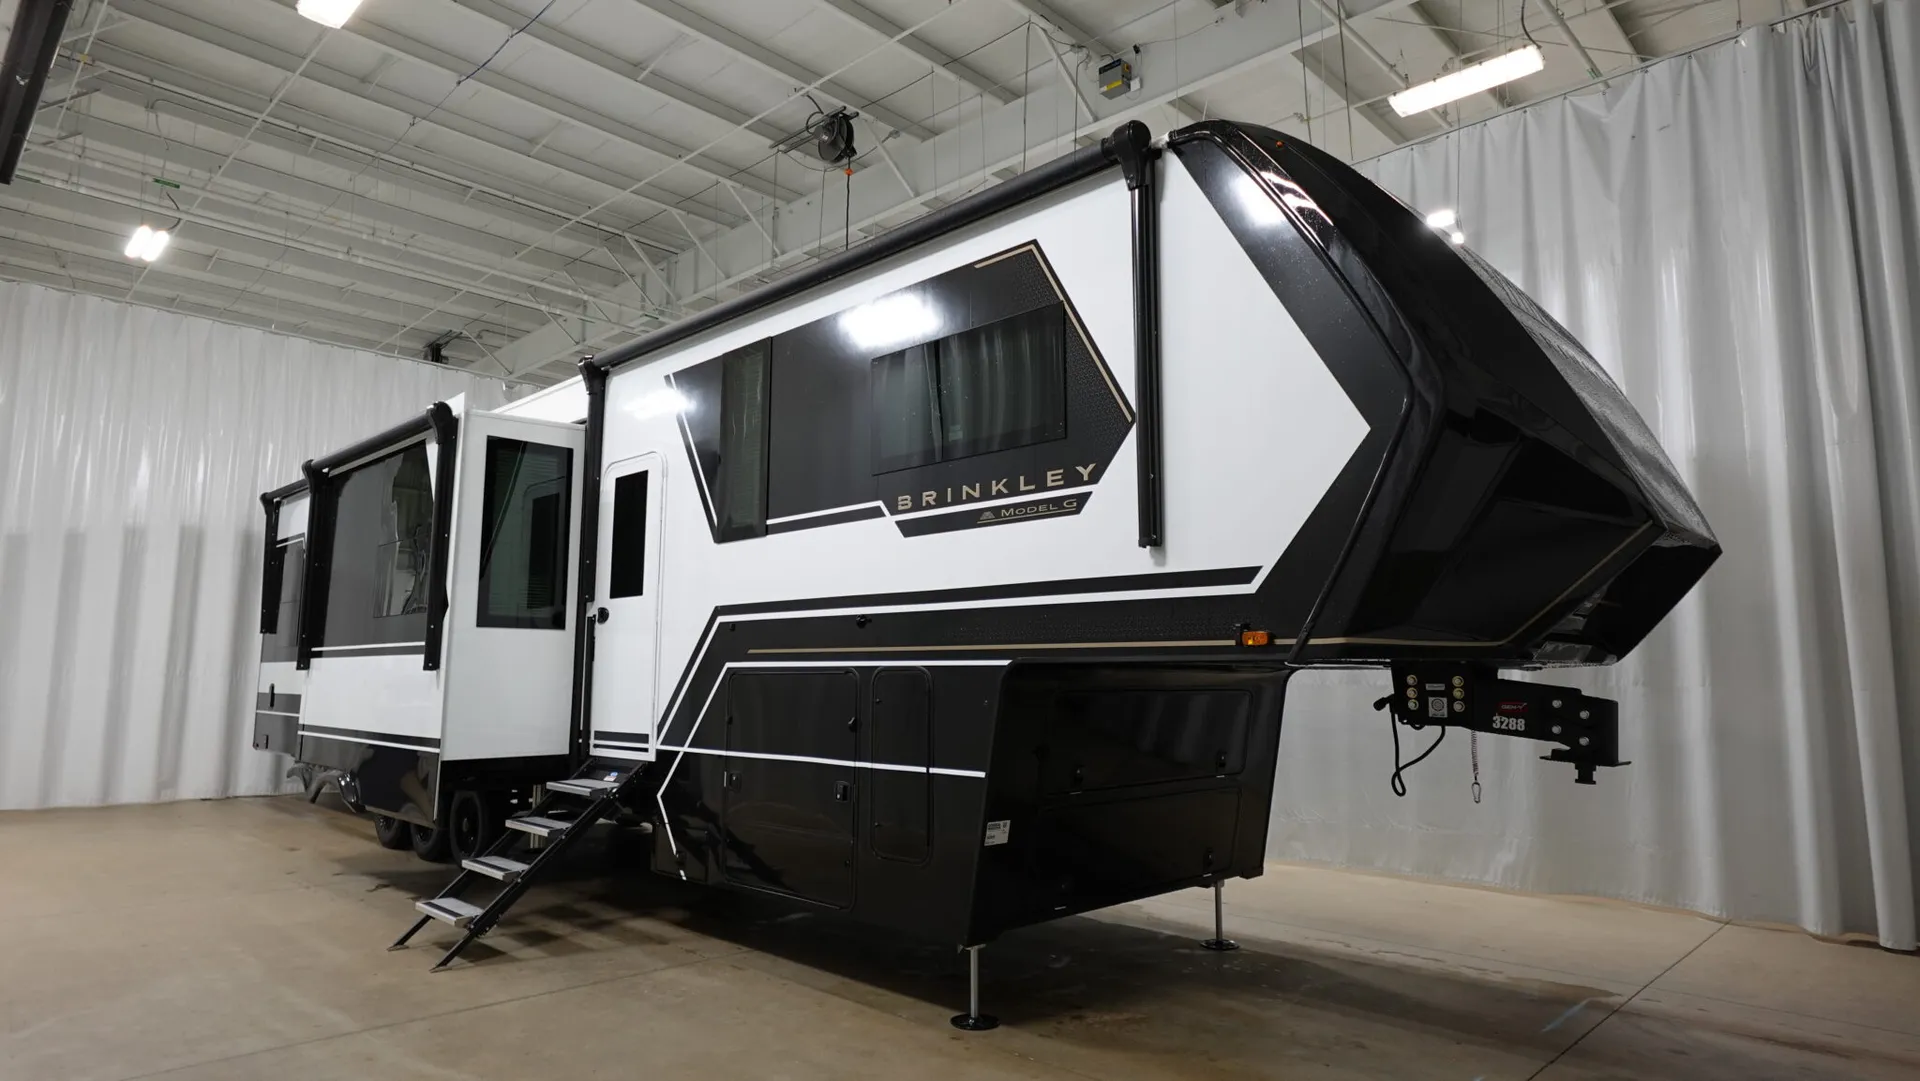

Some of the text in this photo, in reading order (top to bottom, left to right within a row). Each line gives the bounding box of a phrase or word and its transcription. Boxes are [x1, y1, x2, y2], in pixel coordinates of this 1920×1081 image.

[897, 463, 1097, 511] BRINKLEY
[1063, 498, 1077, 508] G
[1492, 716, 1525, 731] 3288
